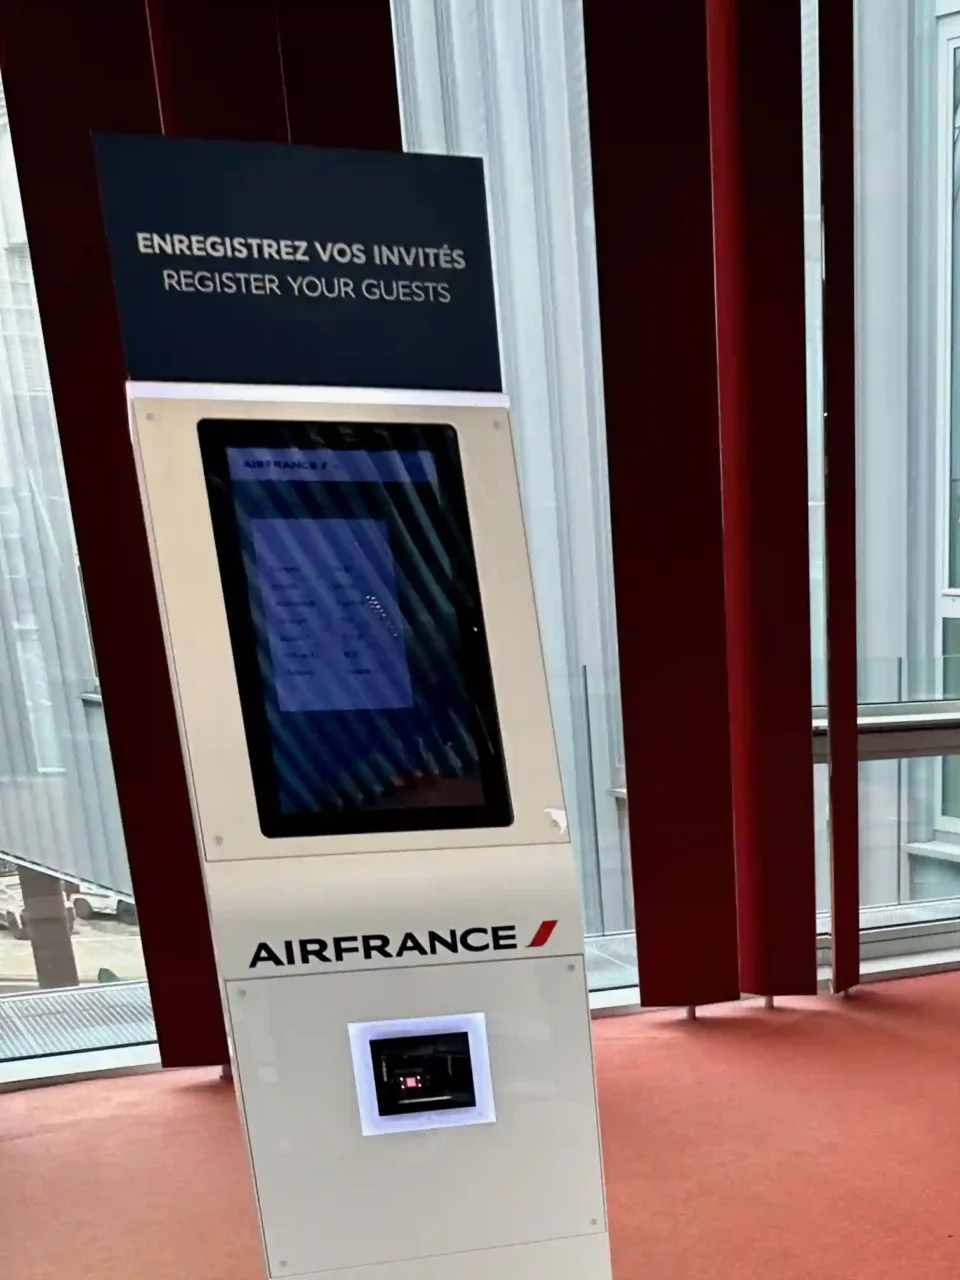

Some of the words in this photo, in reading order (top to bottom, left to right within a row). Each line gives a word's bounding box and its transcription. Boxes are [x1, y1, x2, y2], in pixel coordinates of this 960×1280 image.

[136, 232, 309, 261] ENREGISTREZ
[315, 241, 366, 264] VOS
[374, 244, 466, 269] INVITÉS
[163, 269, 281, 295] REGISTER
[287, 275, 355, 298] YOUR
[362, 279, 451, 303] GUESTS
[249, 925, 517, 969] AIRFRANCE
